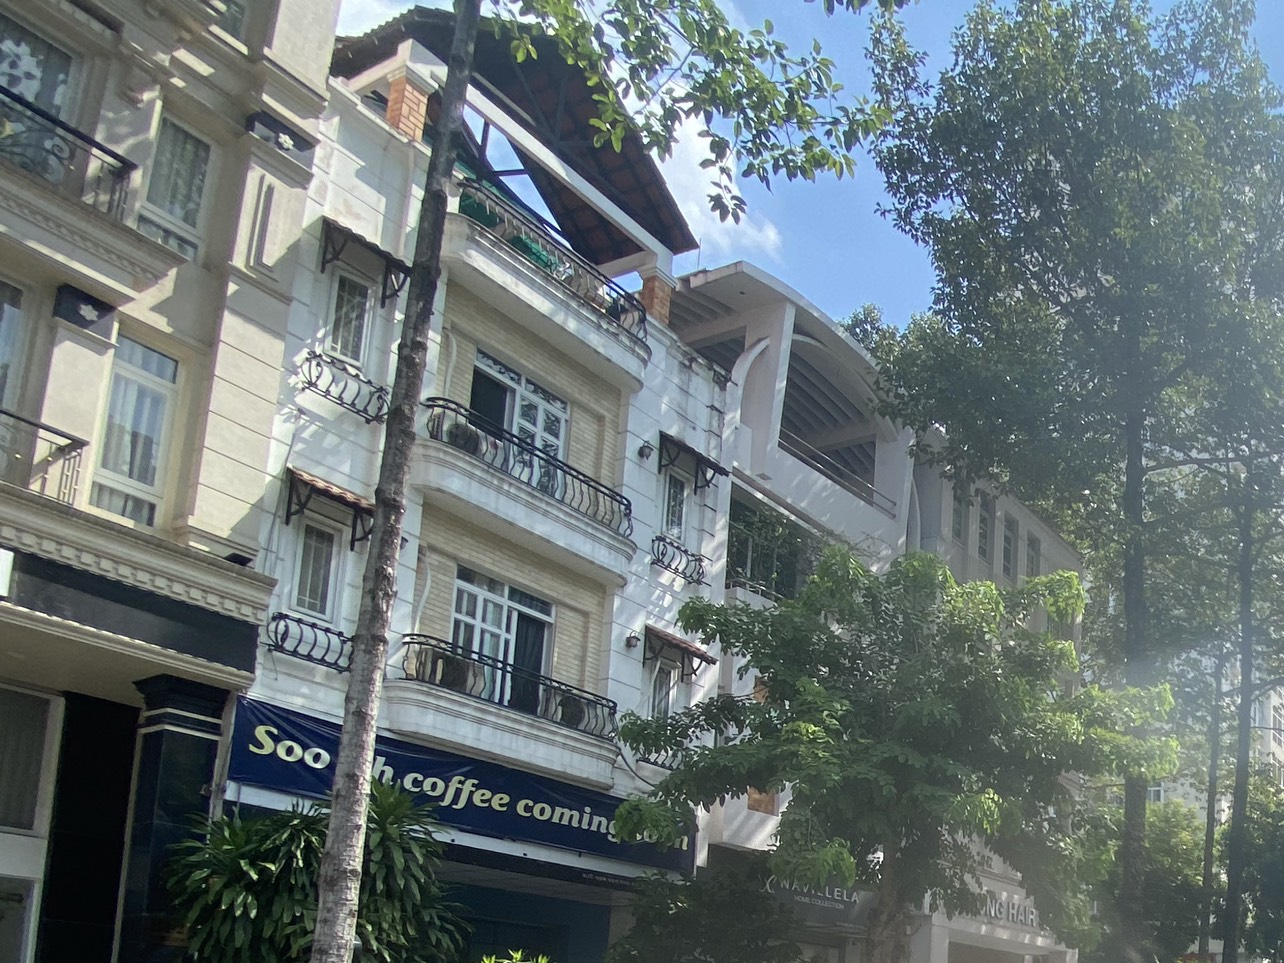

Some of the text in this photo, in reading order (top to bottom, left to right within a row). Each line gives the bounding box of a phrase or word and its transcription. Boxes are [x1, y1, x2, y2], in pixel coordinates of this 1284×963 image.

[403, 772, 511, 812] coffee
[780, 879, 859, 904] NAVILELA
[794, 895, 844, 909] HOME COLLECTION
[1008, 901, 1037, 926] HAIR
